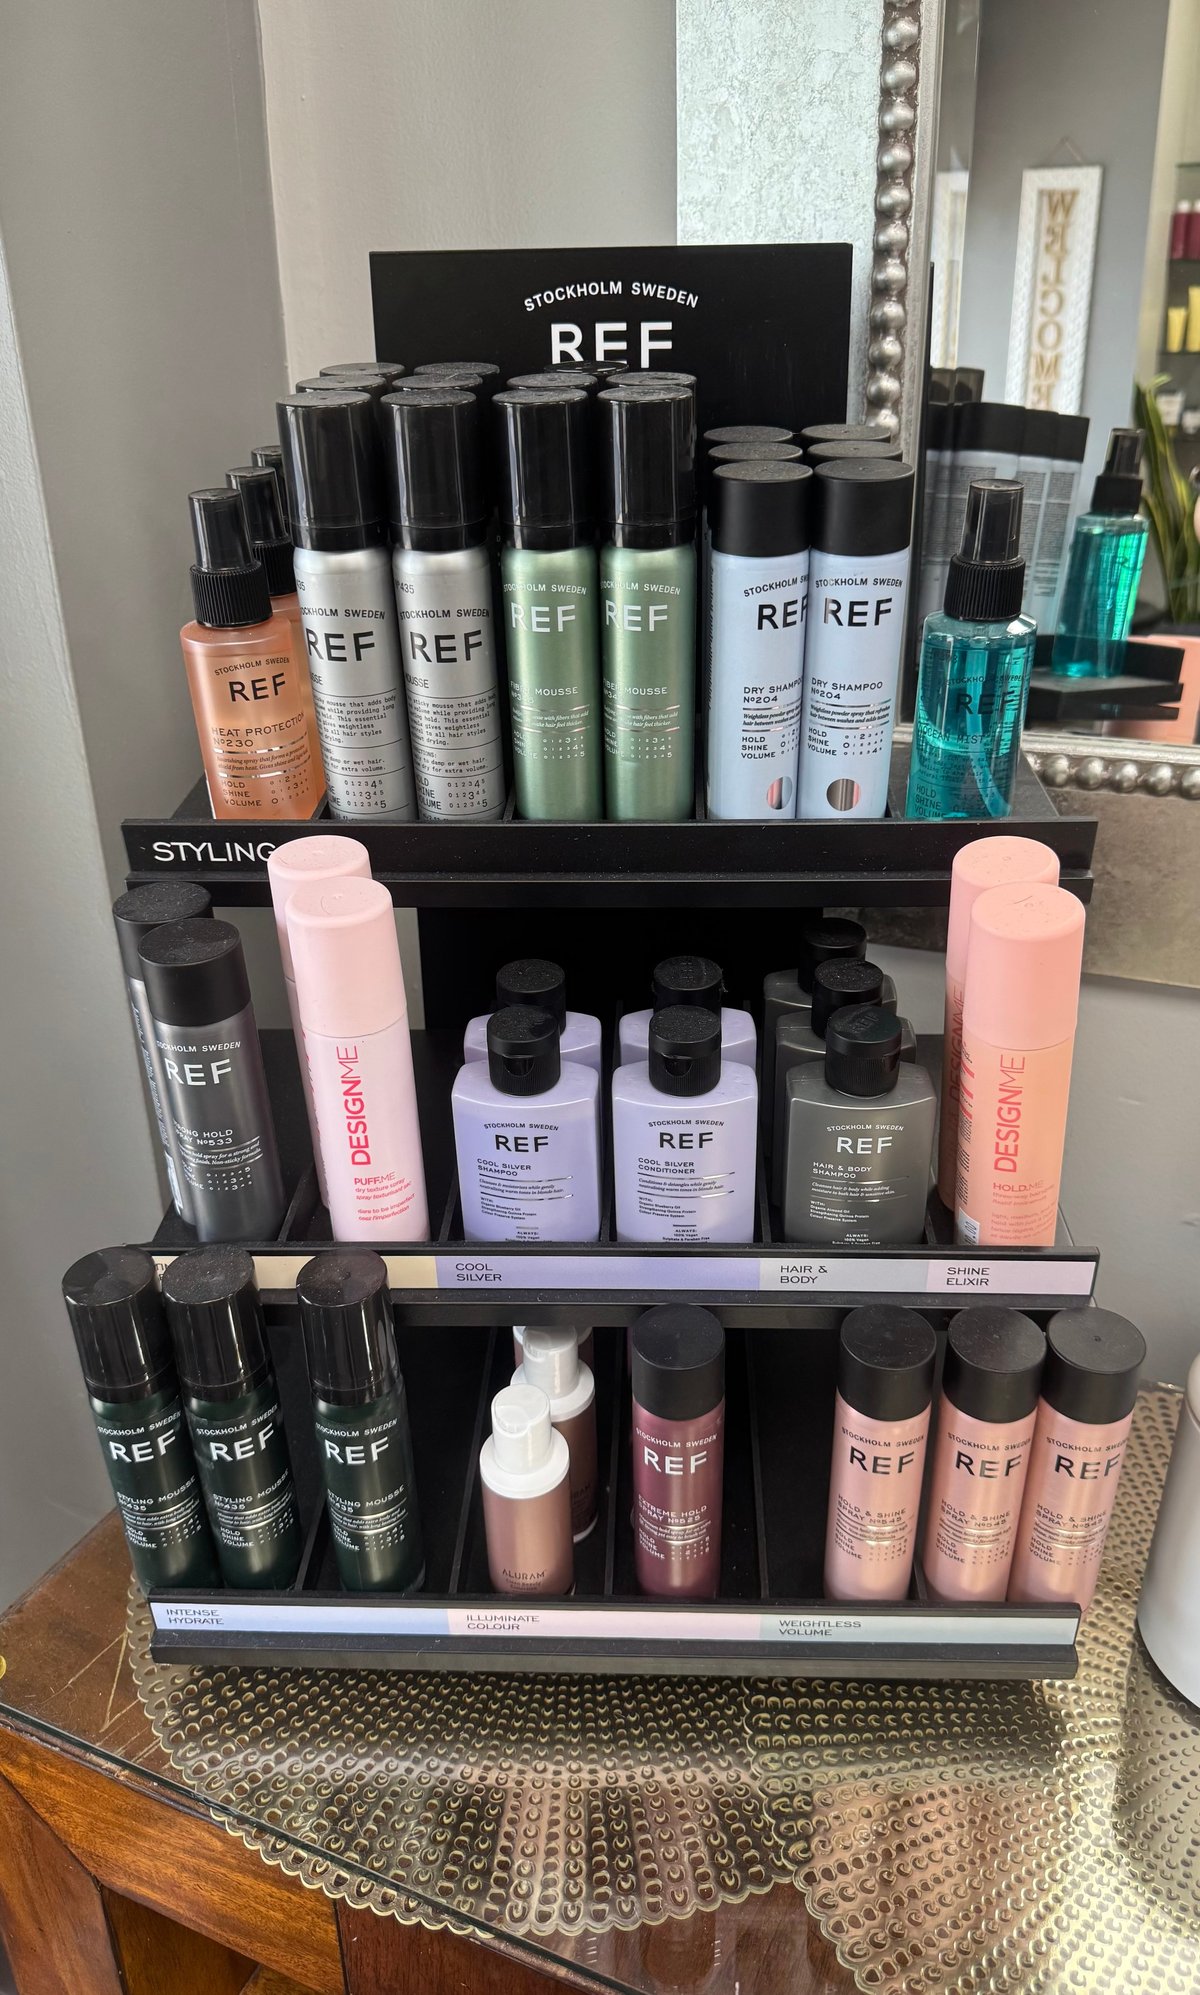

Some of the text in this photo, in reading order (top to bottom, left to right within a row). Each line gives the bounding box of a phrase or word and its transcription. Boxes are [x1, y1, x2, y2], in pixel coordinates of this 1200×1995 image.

[524, 281, 699, 312] STOCKHOLM SWEDEN
[551, 321, 673, 369] REF
[552, 584, 587, 596] SWEDEN
[644, 583, 681, 596] SWEDEN
[744, 577, 798, 598] STOCKHOLM
[815, 577, 868, 588] STOCKHOLM
[872, 577, 904, 588] SWEDEN
[299, 606, 386, 620] OCKHOLM SWEDEN
[400, 608, 490, 620] STOCKHOLM SWEDEN
[511, 602, 576, 633] REF
[606, 600, 668, 632] REF
[824, 597, 892, 628] REF
[305, 628, 376, 662] REF
[410, 629, 483, 664] REF
[214, 657, 290, 676] STOCKHOLM SWEDEN
[228, 673, 286, 702] REF
[535, 686, 578, 696] MOUSSE
[624, 686, 668, 696] MOUSSE
[744, 678, 802, 694] DRY SHAMPO
[811, 677, 883, 692] DRY SHAMPOO
[955, 690, 1015, 716] REF
[346, 708, 380, 716] providing
[354, 713, 387, 722] essential
[454, 706, 485, 717] providing
[211, 712, 304, 738] HEAT PROTECTION
[338, 723, 374, 731] weightless
[808, 727, 828, 738] HOLD
[807, 742, 838, 756] VOLUME
[808, 735, 830, 747] SHINE
[223, 789, 250, 798] SHINE
[916, 784, 937, 799] HOLD
[224, 798, 262, 806] VOLUME
[915, 795, 942, 810] SHINE
[152, 842, 276, 862] STYLING
[202, 1041, 241, 1052] SWEDEN
[164, 1058, 232, 1086] REF
[336, 1046, 372, 1166] DESIGNME
[994, 1054, 1026, 1173] DESIGNME
[203, 1129, 234, 1139] HOLD
[529, 1123, 559, 1131] SWEDEN
[826, 1124, 872, 1132] STOCKHOLM
[495, 1134, 549, 1152] REF
[660, 1132, 714, 1150] REF
[836, 1136, 893, 1154] REF
[477, 1158, 499, 1168] COOL
[638, 1158, 661, 1166] COOL
[638, 1164, 696, 1174] CONDITIONER
[813, 1162, 834, 1170] HAIR
[478, 1165, 518, 1176] SHAMPOO
[812, 1168, 857, 1179] SHAMPOO
[456, 1262, 494, 1271] COOL
[780, 1265, 828, 1274] HAIR &
[947, 1266, 990, 1276] SHINE
[456, 1273, 502, 1282] SILVER
[780, 1276, 818, 1284] BODY
[946, 1278, 990, 1286] ELIXIR
[97, 1411, 181, 1436] STOCKHOLM SWEDEN
[196, 1402, 278, 1436] STOCKHOLM SWEDEN
[364, 1417, 398, 1436] SWEDEN
[210, 1422, 274, 1462] REF
[636, 1428, 718, 1448] STOCKHOLM SWEDEN
[842, 1426, 891, 1447] STOCKHOLM
[948, 1432, 1000, 1451] STOCKHOLM
[1046, 1437, 1102, 1452] STOCKHOLM
[109, 1429, 176, 1462] REF
[324, 1436, 389, 1466] REF
[644, 1446, 707, 1476] REF
[850, 1446, 914, 1474] REF
[956, 1450, 1022, 1478] REF
[1054, 1454, 1120, 1480] REF
[116, 1475, 196, 1505] STYLING MOUSSE
[213, 1468, 289, 1504] STYLING MOUSSE
[327, 1484, 405, 1508] STYLING MOUSSE
[638, 1494, 707, 1518] EXTREME HOLD
[638, 1502, 664, 1522] SPRAY
[838, 1494, 861, 1513] HOLD
[876, 1508, 906, 1519] SHINE
[838, 1501, 866, 1521] SPRAY
[942, 1499, 1010, 1522] HOLD SHINE
[1037, 1504, 1064, 1520] HOLD
[941, 1504, 970, 1525] SPRAY
[1036, 1510, 1068, 1526] SPRAY
[223, 1538, 254, 1548] VOLUME
[835, 1533, 855, 1550] SHINE
[836, 1528, 853, 1544] HOLD
[937, 1532, 956, 1548] HOLD
[1032, 1536, 1052, 1552] HOLD
[834, 1539, 862, 1560] VOLUME
[936, 1538, 958, 1555] SHINE
[936, 1543, 966, 1564] VOLUME
[1030, 1542, 1054, 1558] SHINE
[502, 1568, 545, 1580] ALURAM
[166, 1608, 220, 1616] INTENSE
[466, 1614, 540, 1622] ILLUMINATE
[779, 1620, 862, 1628] WEIGHTLESS
